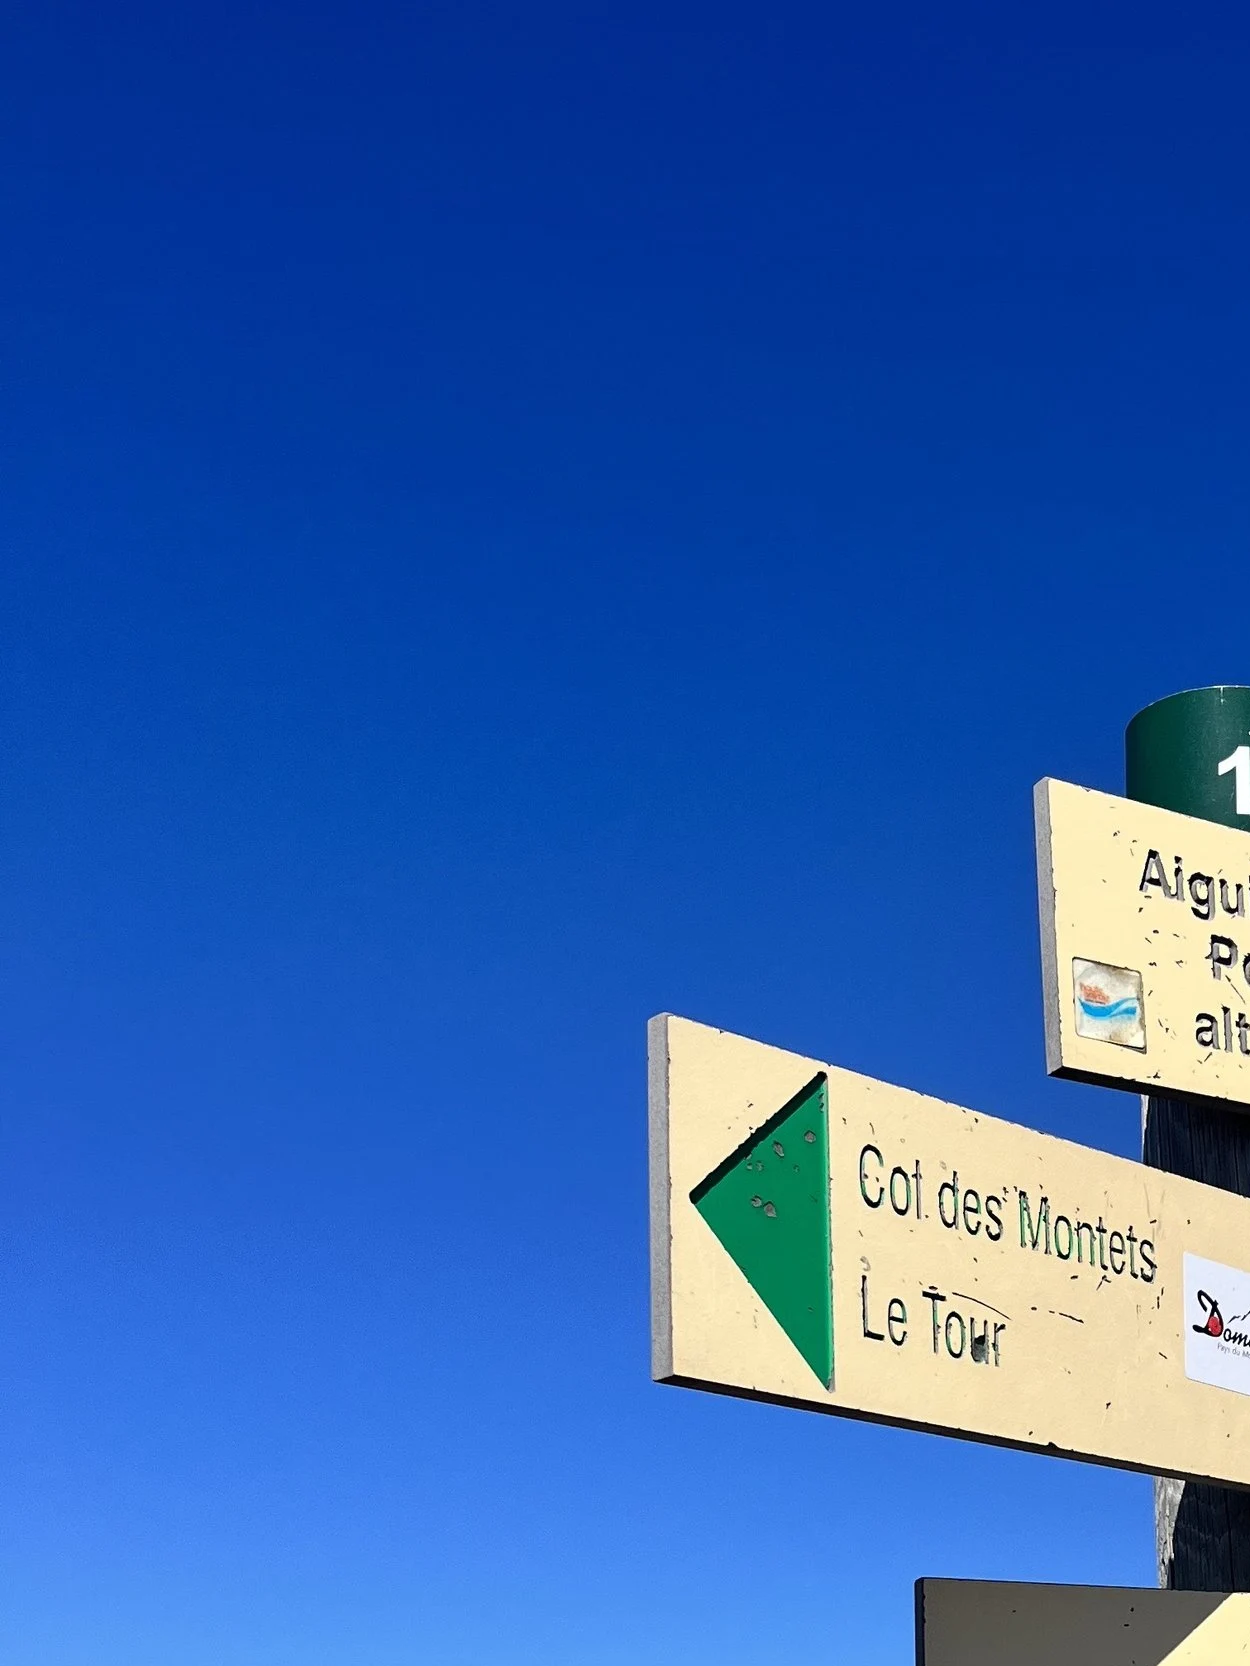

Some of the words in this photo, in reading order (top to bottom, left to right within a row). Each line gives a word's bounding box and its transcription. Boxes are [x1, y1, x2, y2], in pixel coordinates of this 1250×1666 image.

[859, 1144, 923, 1220] Col
[939, 1171, 1003, 1241] des
[1018, 1189, 1158, 1283] Montets
[860, 1275, 908, 1346] Le
[922, 1289, 1007, 1367] Tour
